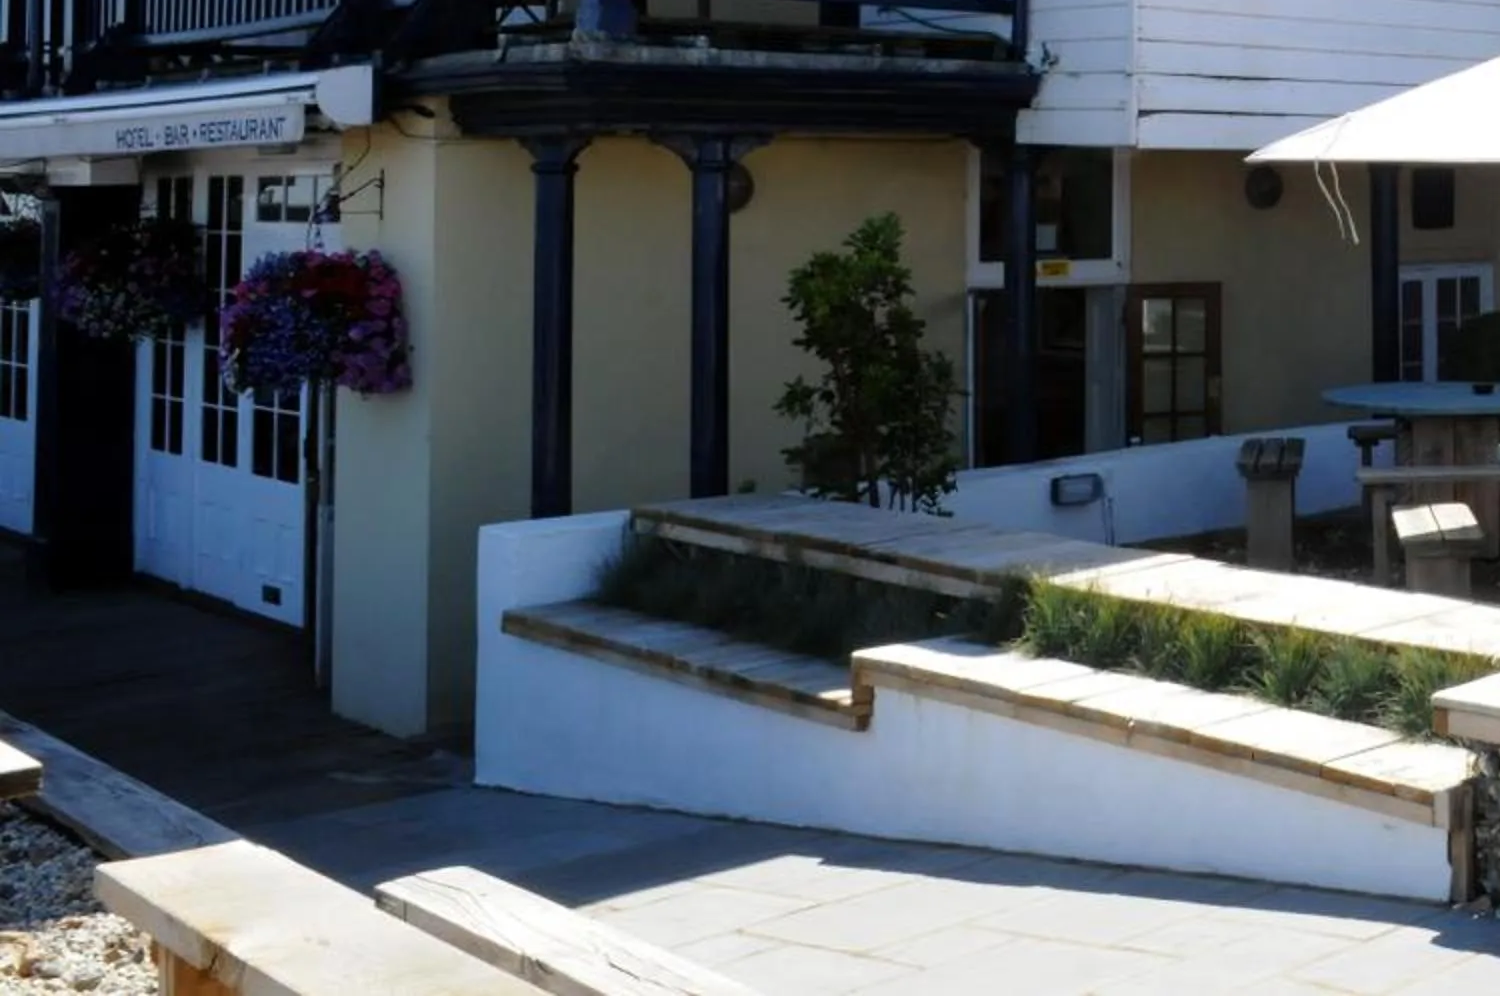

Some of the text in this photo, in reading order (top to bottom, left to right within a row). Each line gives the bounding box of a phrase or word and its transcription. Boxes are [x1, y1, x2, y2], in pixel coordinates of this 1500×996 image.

[116, 116, 287, 149] HOTEL BAR RESTAURANT
